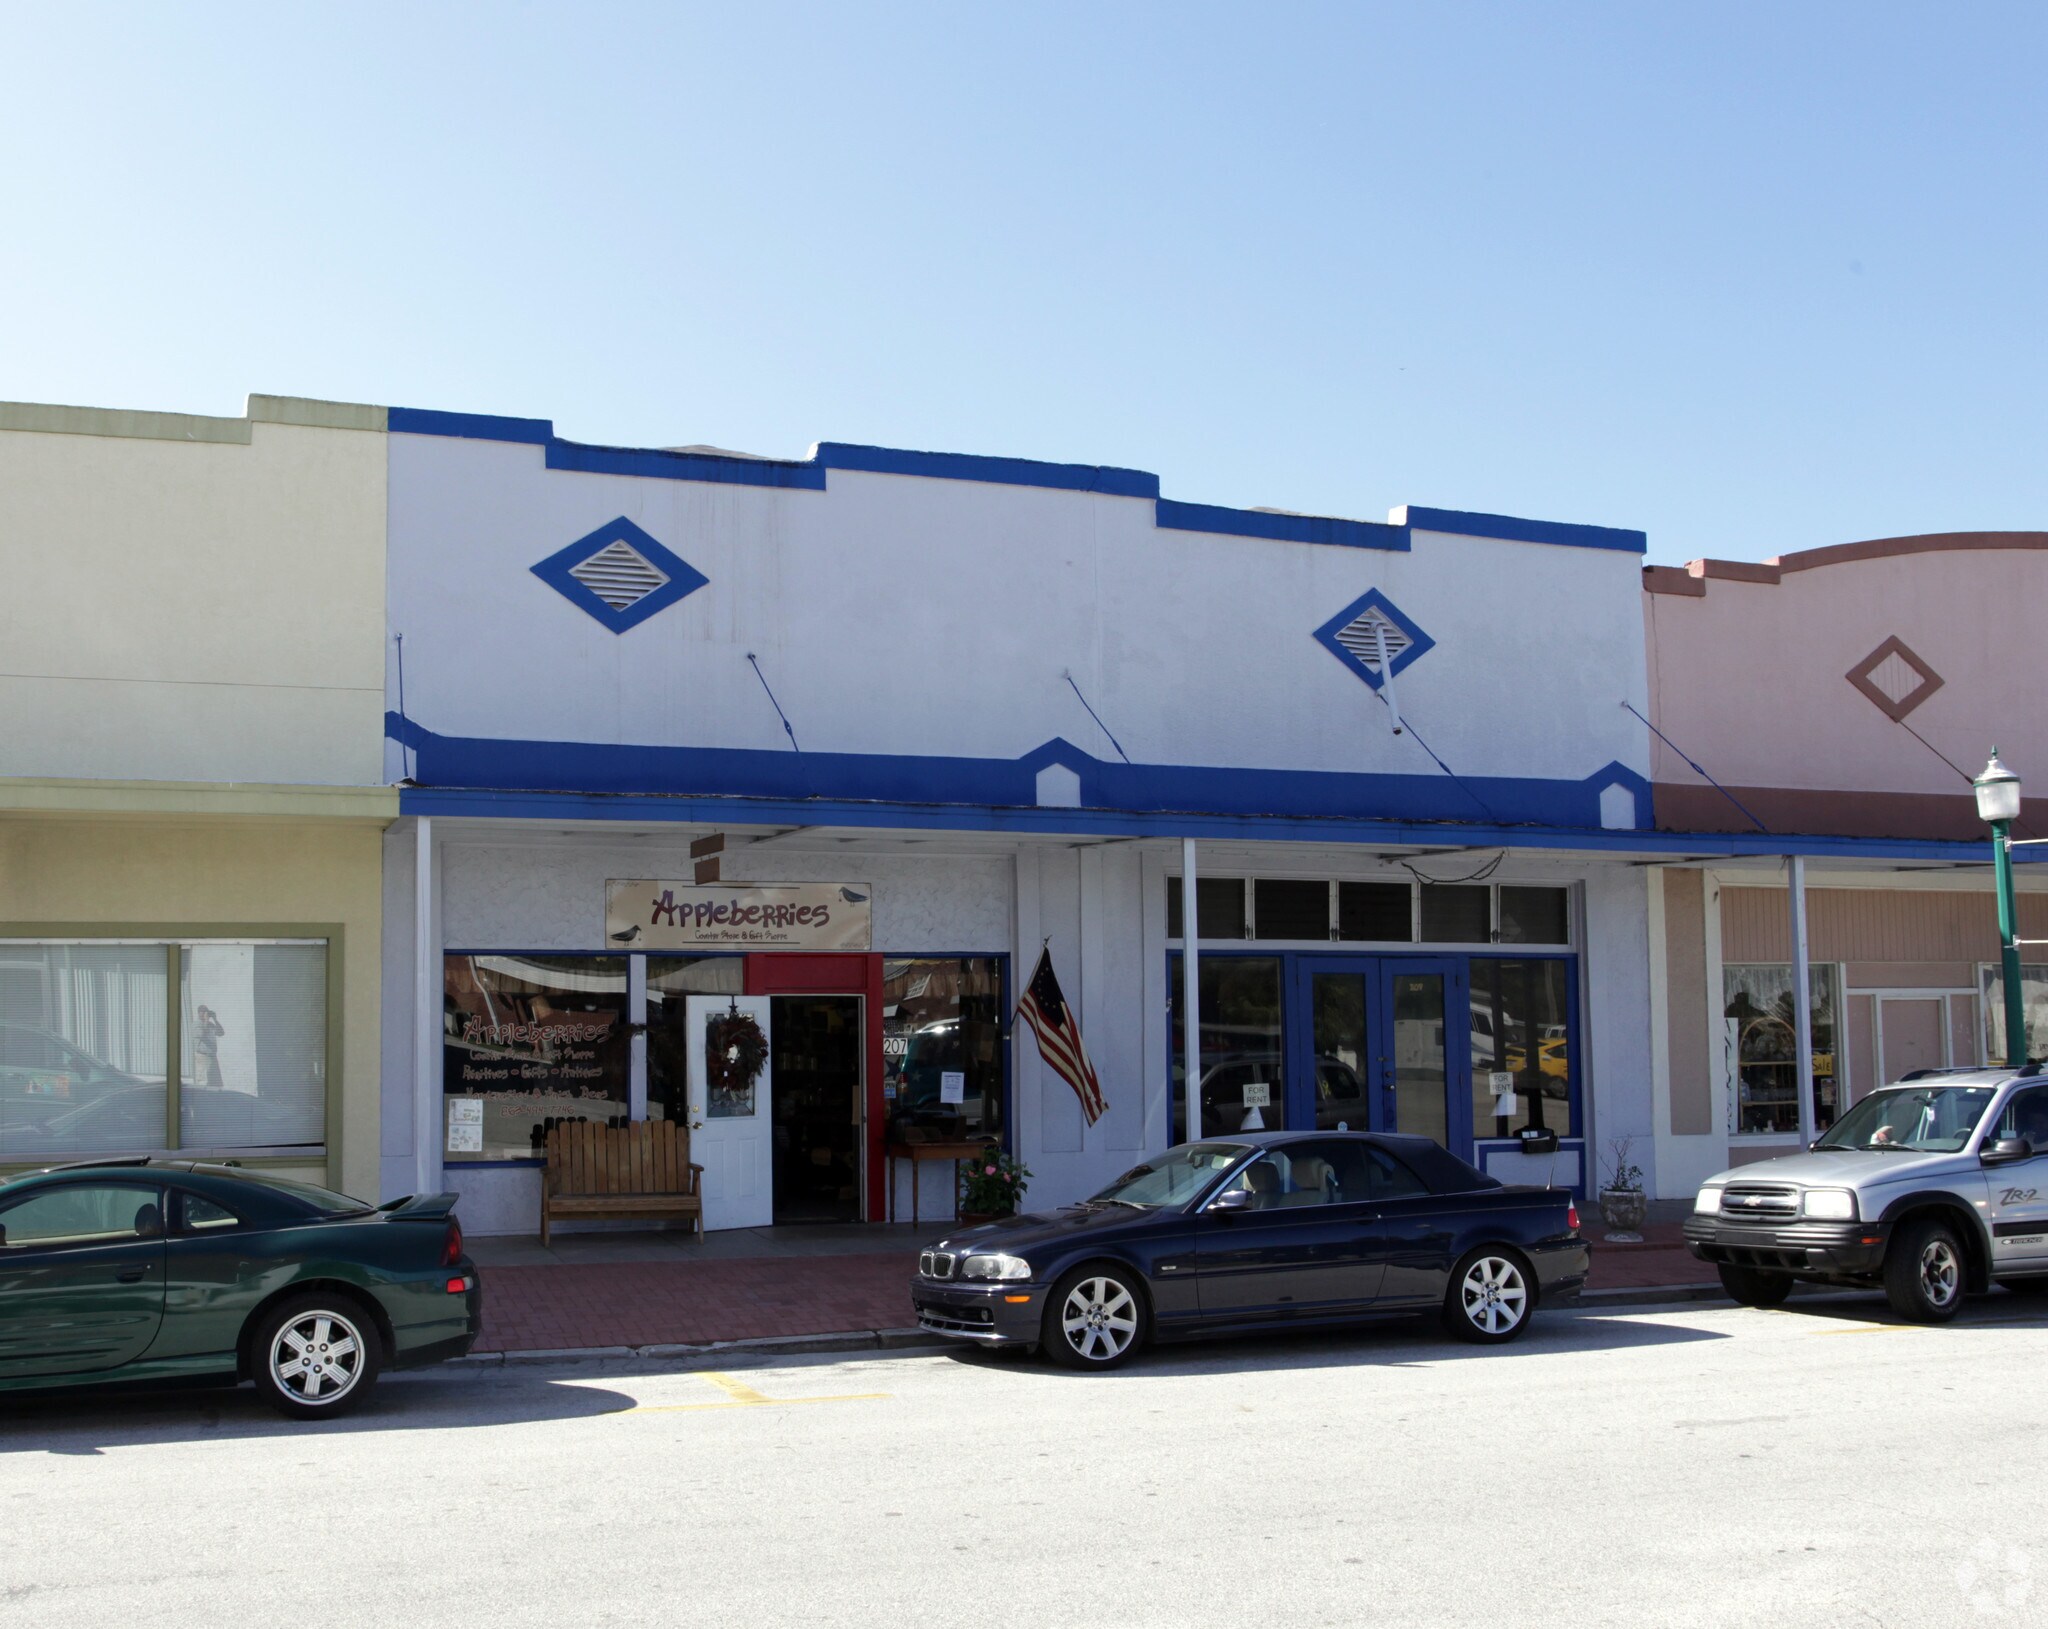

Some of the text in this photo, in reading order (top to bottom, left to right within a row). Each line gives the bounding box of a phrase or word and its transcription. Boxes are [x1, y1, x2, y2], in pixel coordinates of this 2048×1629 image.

[651, 889, 830, 929] Appleberries
[741, 931, 748, 940] &
[749, 930, 763, 940] Gift
[462, 1015, 611, 1045] Appleberries
[884, 1039, 907, 1054] 207
[1248, 1086, 1265, 1094] FOR
[1492, 1084, 1511, 1092] RENT
[1246, 1096, 1267, 1104] RENT
[1999, 1187, 2042, 1206] ZR-2
